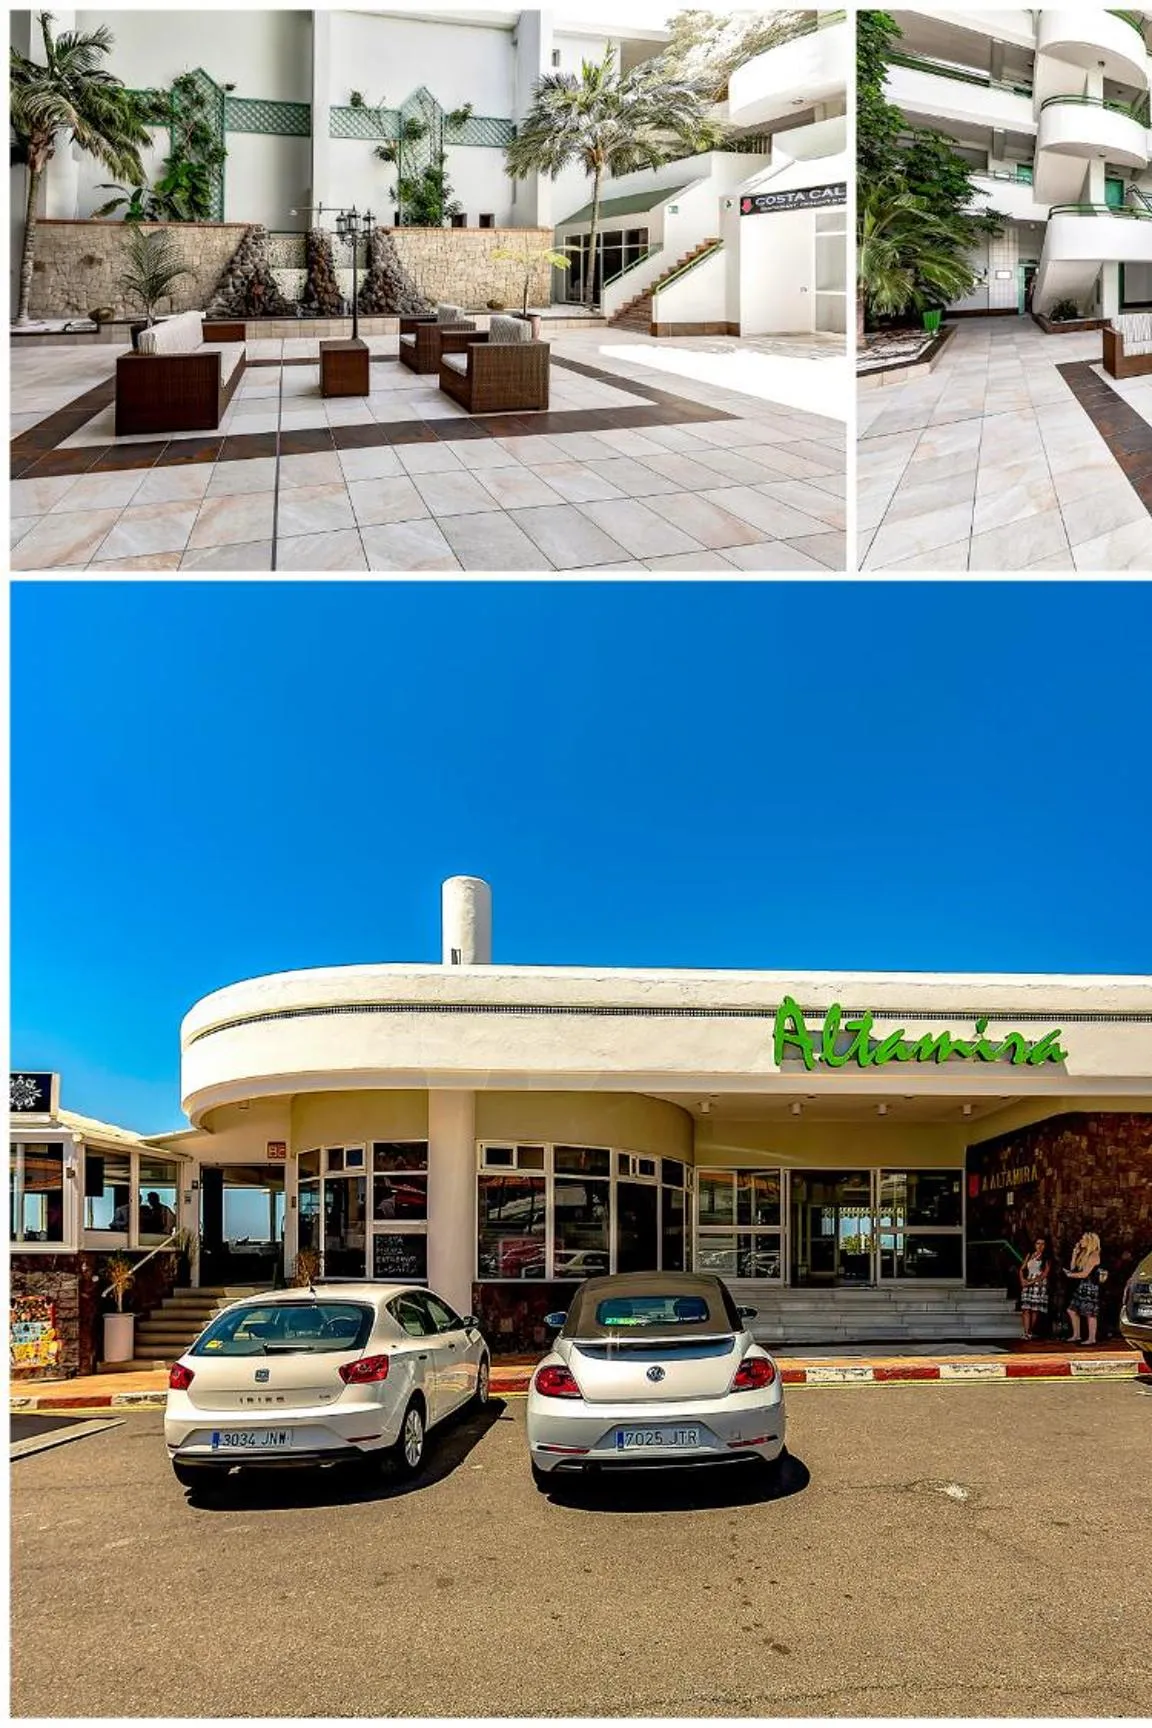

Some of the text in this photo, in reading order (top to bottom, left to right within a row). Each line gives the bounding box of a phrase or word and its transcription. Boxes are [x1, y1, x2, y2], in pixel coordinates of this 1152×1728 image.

[755, 192, 806, 206] COSTA
[773, 995, 1068, 1071] Altamira
[990, 1164, 1038, 1190] ALTAMIRA
[223, 1430, 287, 1447] 3034 JNW
[625, 1428, 698, 1447] 7025 JTR
